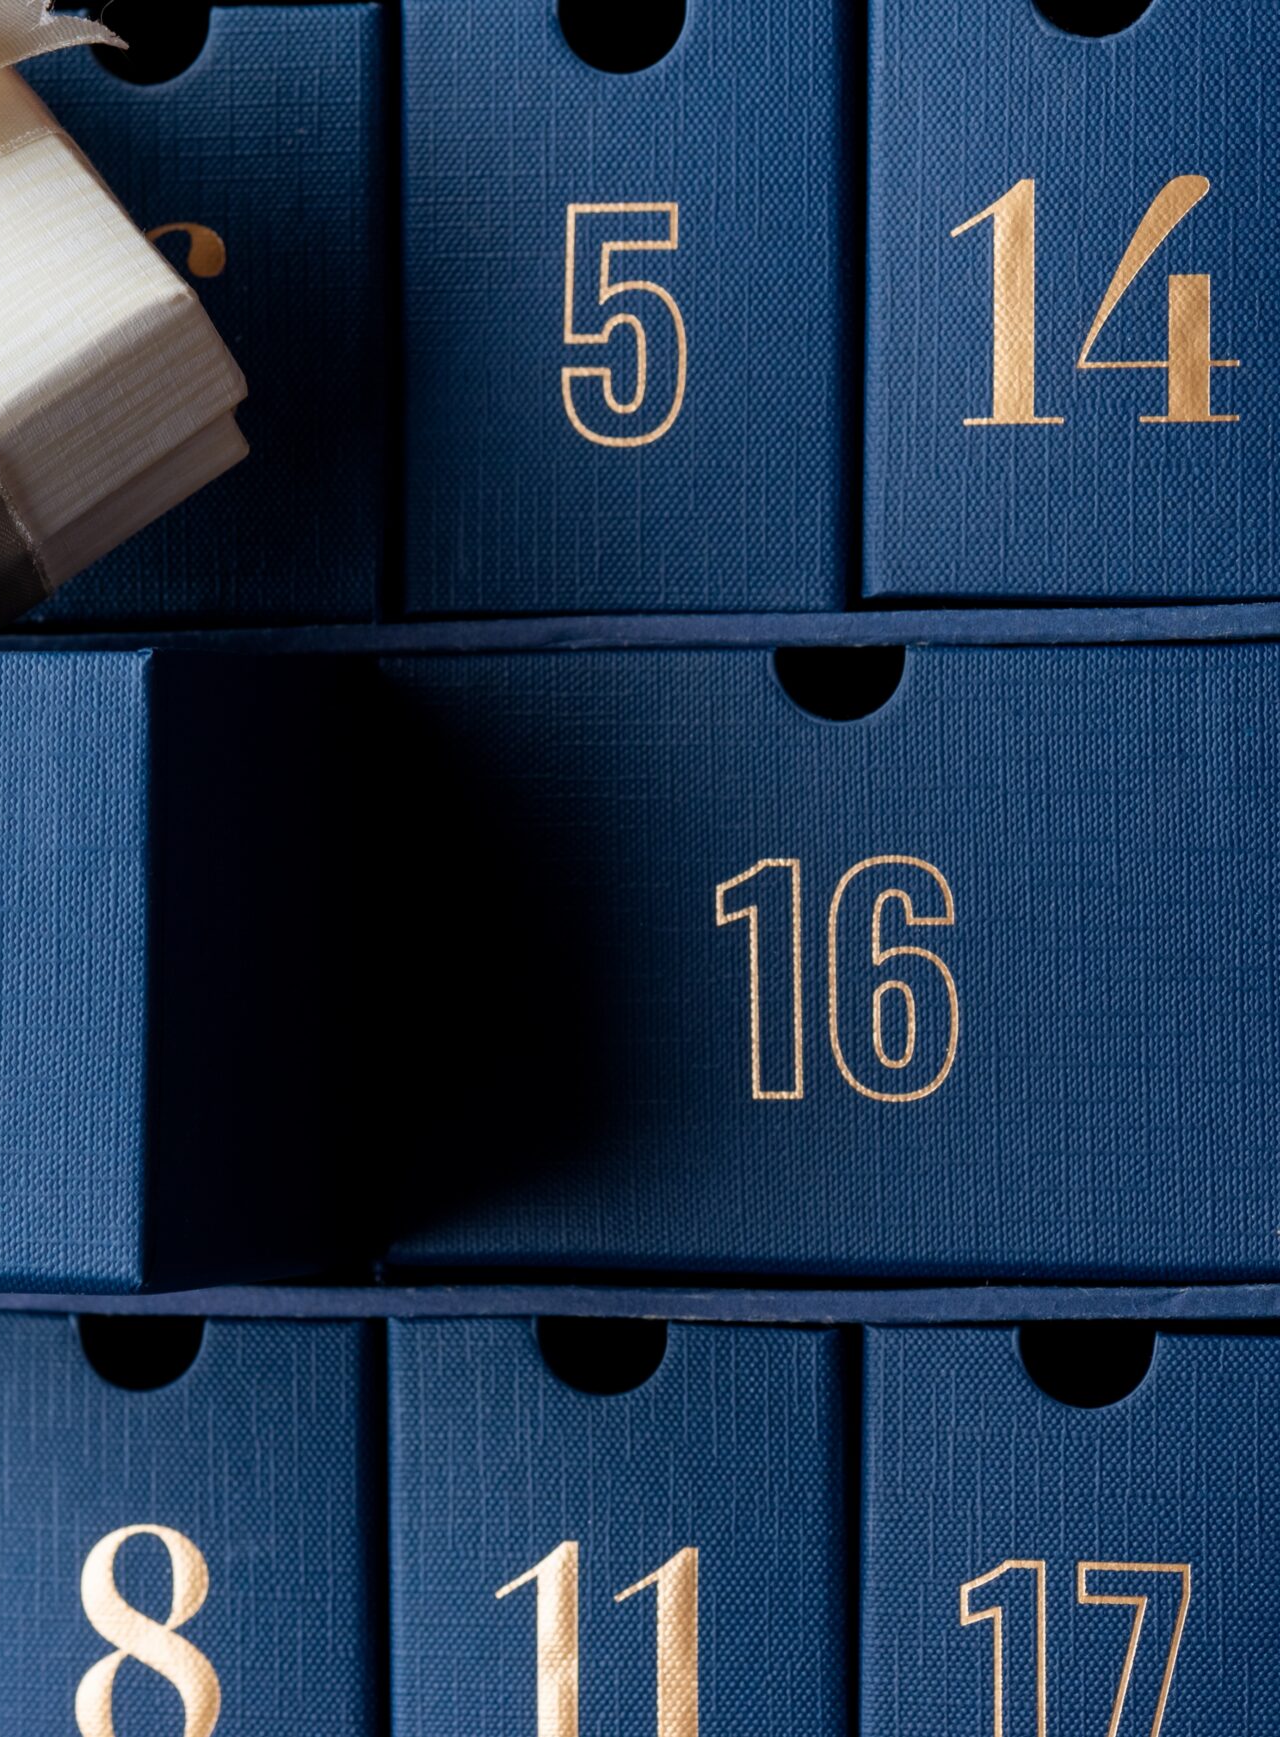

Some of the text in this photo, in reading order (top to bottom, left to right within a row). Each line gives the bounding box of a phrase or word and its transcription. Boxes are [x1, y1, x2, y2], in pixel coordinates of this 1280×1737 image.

[560, 201, 688, 448] 5
[949, 174, 1242, 428] 14
[714, 855, 961, 1104] 16
[74, 1523, 221, 1737] 8
[494, 1540, 701, 1737] 11
[959, 1558, 1193, 1737] 17
